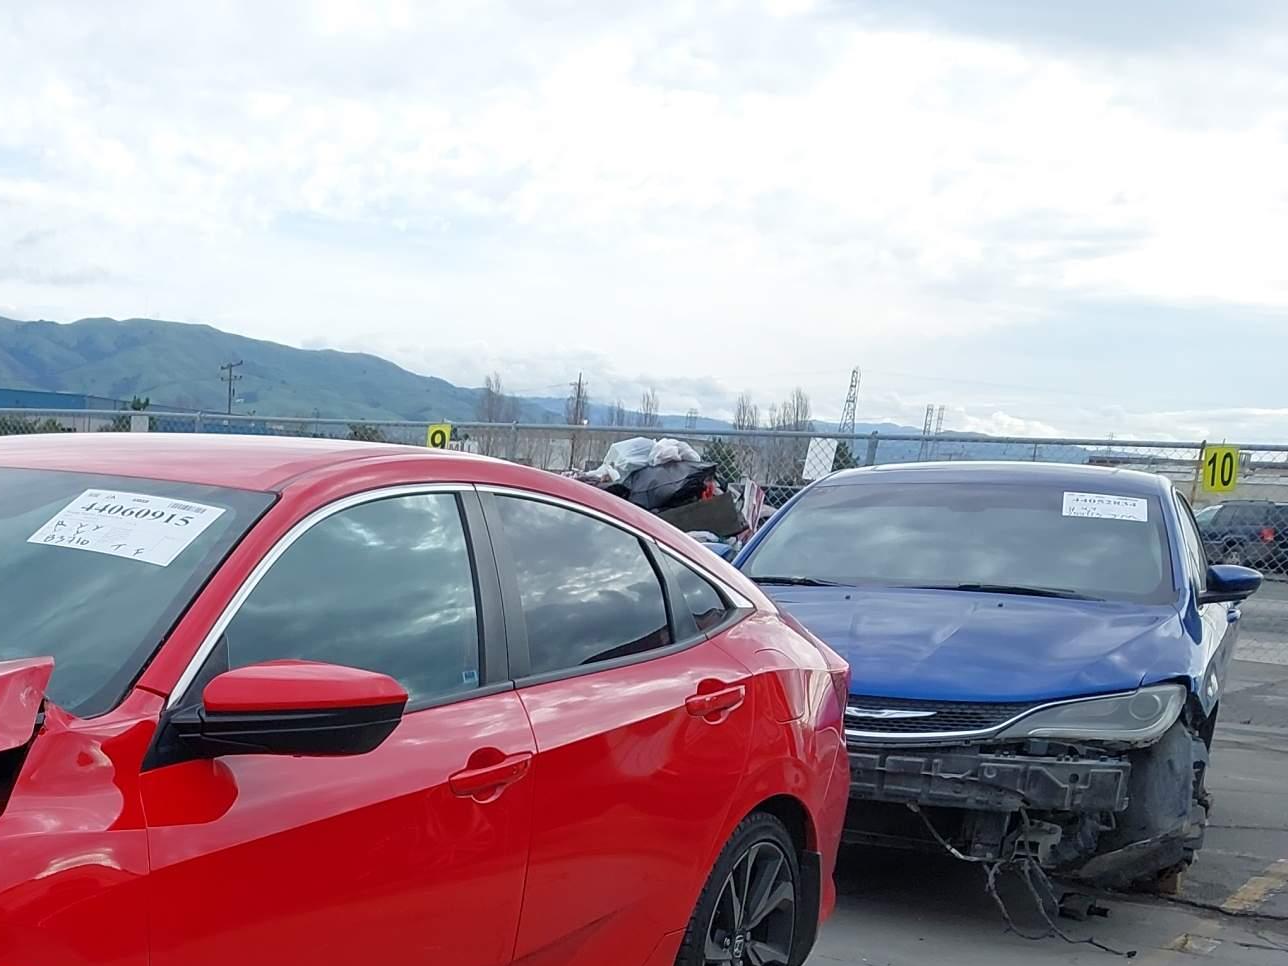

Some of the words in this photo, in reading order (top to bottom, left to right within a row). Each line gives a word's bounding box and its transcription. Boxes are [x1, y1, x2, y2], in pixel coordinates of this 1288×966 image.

[430, 429, 446, 449] 9
[1207, 451, 1234, 487] 10
[81, 501, 195, 527] 44060915
